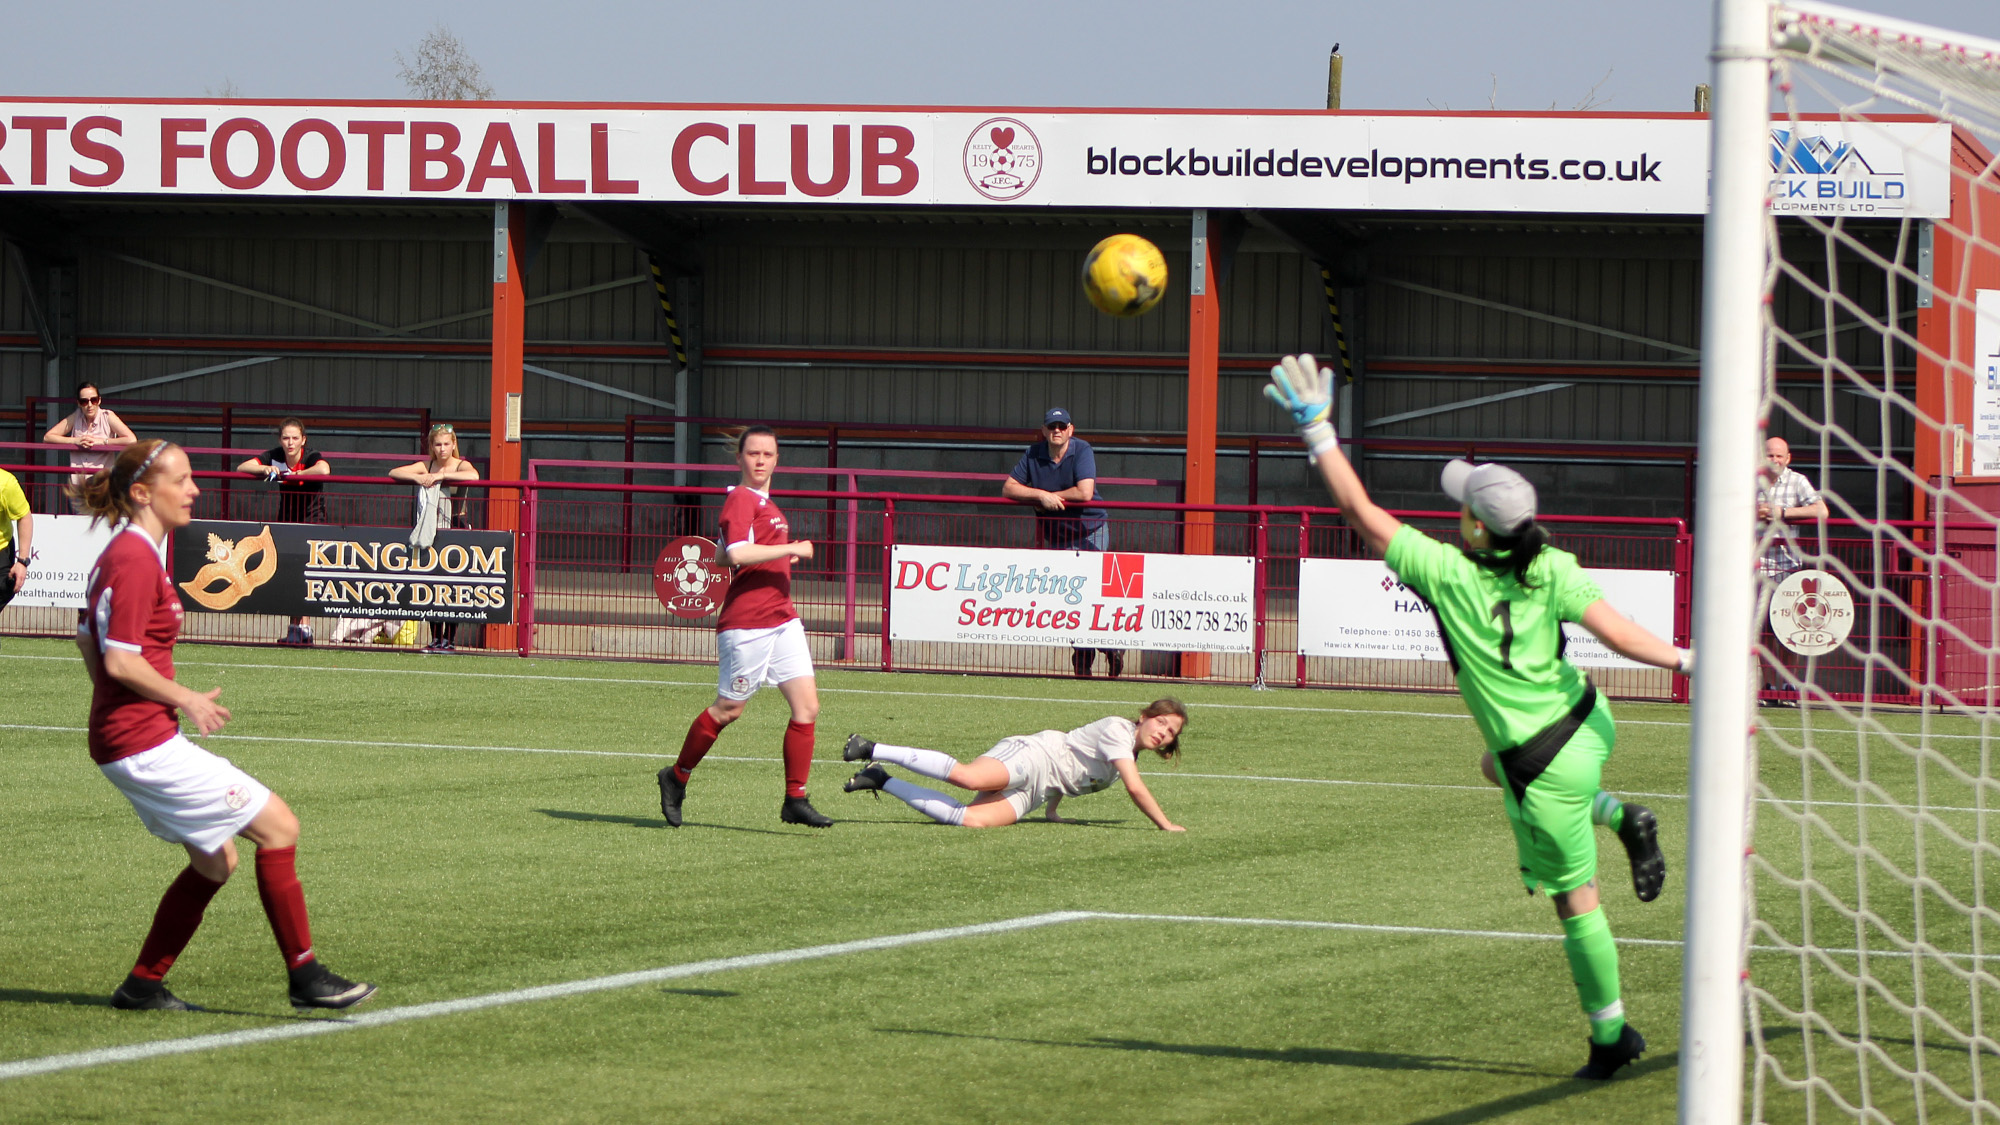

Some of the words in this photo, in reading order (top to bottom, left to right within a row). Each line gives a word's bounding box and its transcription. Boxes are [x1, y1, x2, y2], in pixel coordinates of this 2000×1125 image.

[0, 115, 125, 188] TS
[160, 117, 639, 195] FOOTBALL
[671, 122, 920, 197] CLUB
[972, 154, 988, 167] 19
[1016, 155, 1035, 168] 75
[1087, 146, 1662, 184] blockbuilddevelopments.co.uk
[1817, 180, 1905, 199] BUILD
[1769, 203, 1845, 211] LOPMENTS
[1850, 204, 1875, 212] LTD
[305, 539, 507, 575] KINGDOM
[46, 571, 64, 581] 019
[662, 573, 673, 582] 19
[710, 573, 722, 583] 75
[894, 560, 951, 592] DC
[954, 563, 1087, 605] Lighting
[304, 579, 405, 605] FANCY
[409, 583, 506, 608] DRESS
[1152, 590, 1248, 603] sales@dcls.co.uk
[324, 606, 488, 619] www.kingdomfancydress.co.uk
[957, 599, 1080, 630] Services
[1088, 603, 1145, 633] Ltd
[1780, 608, 1791, 617] 19
[1832, 608, 1844, 617] 75
[1151, 609, 1191, 630] 01382
[1196, 611, 1219, 631] 738
[1223, 612, 1247, 632] 236
[1339, 626, 1391, 637] Telephone:
[1394, 629, 1422, 638] 01450
[1490, 600, 1514, 669] 1
[956, 632, 998, 641] SPORTS
[1000, 634, 1084, 645] FLOODLIGHTING
[1086, 637, 1146, 647] SPECIALIST
[1152, 641, 1245, 651] www.sports-lighting.co.uk
[1324, 641, 1352, 649] Hawick
[1354, 642, 1389, 650] Knitwear
[1573, 650, 1608, 659] Scotland
